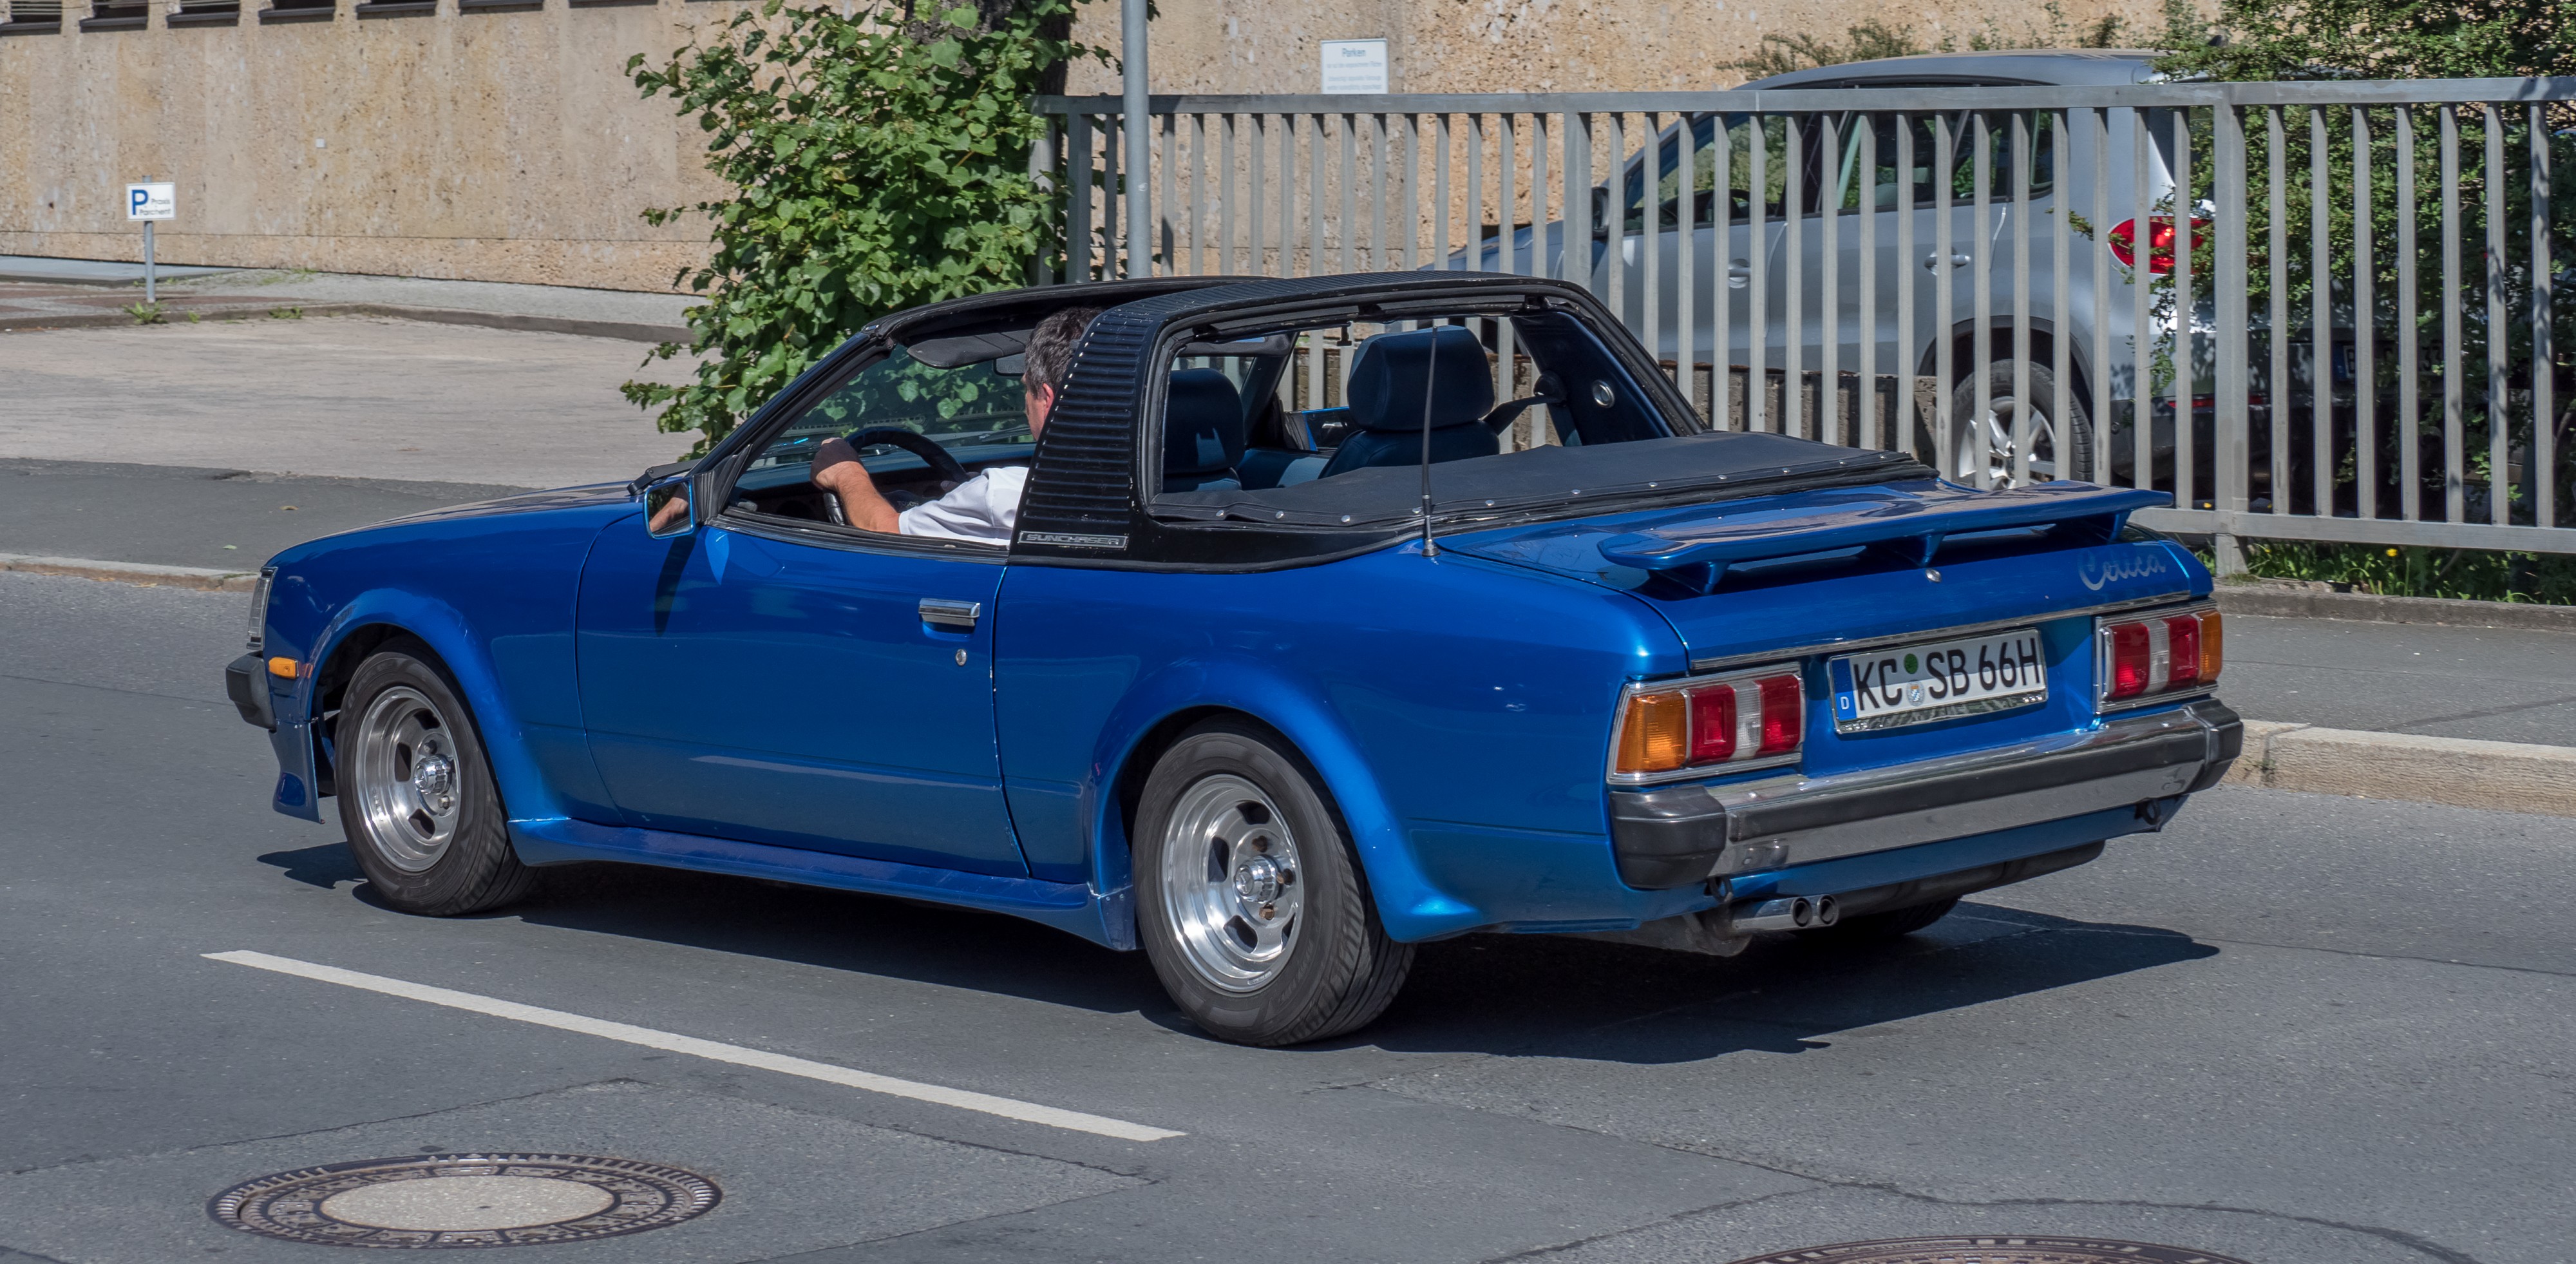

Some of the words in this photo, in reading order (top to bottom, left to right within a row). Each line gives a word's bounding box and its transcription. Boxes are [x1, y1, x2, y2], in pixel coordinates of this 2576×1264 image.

[1341, 48, 1366, 57] Parken
[131, 189, 149, 216] P
[1027, 533, 1119, 546] SUNCHASER
[1853, 658, 1902, 711] KC
[1926, 649, 1970, 699] SB
[1978, 637, 2041, 691] 66H
[1840, 696, 1850, 710] D
